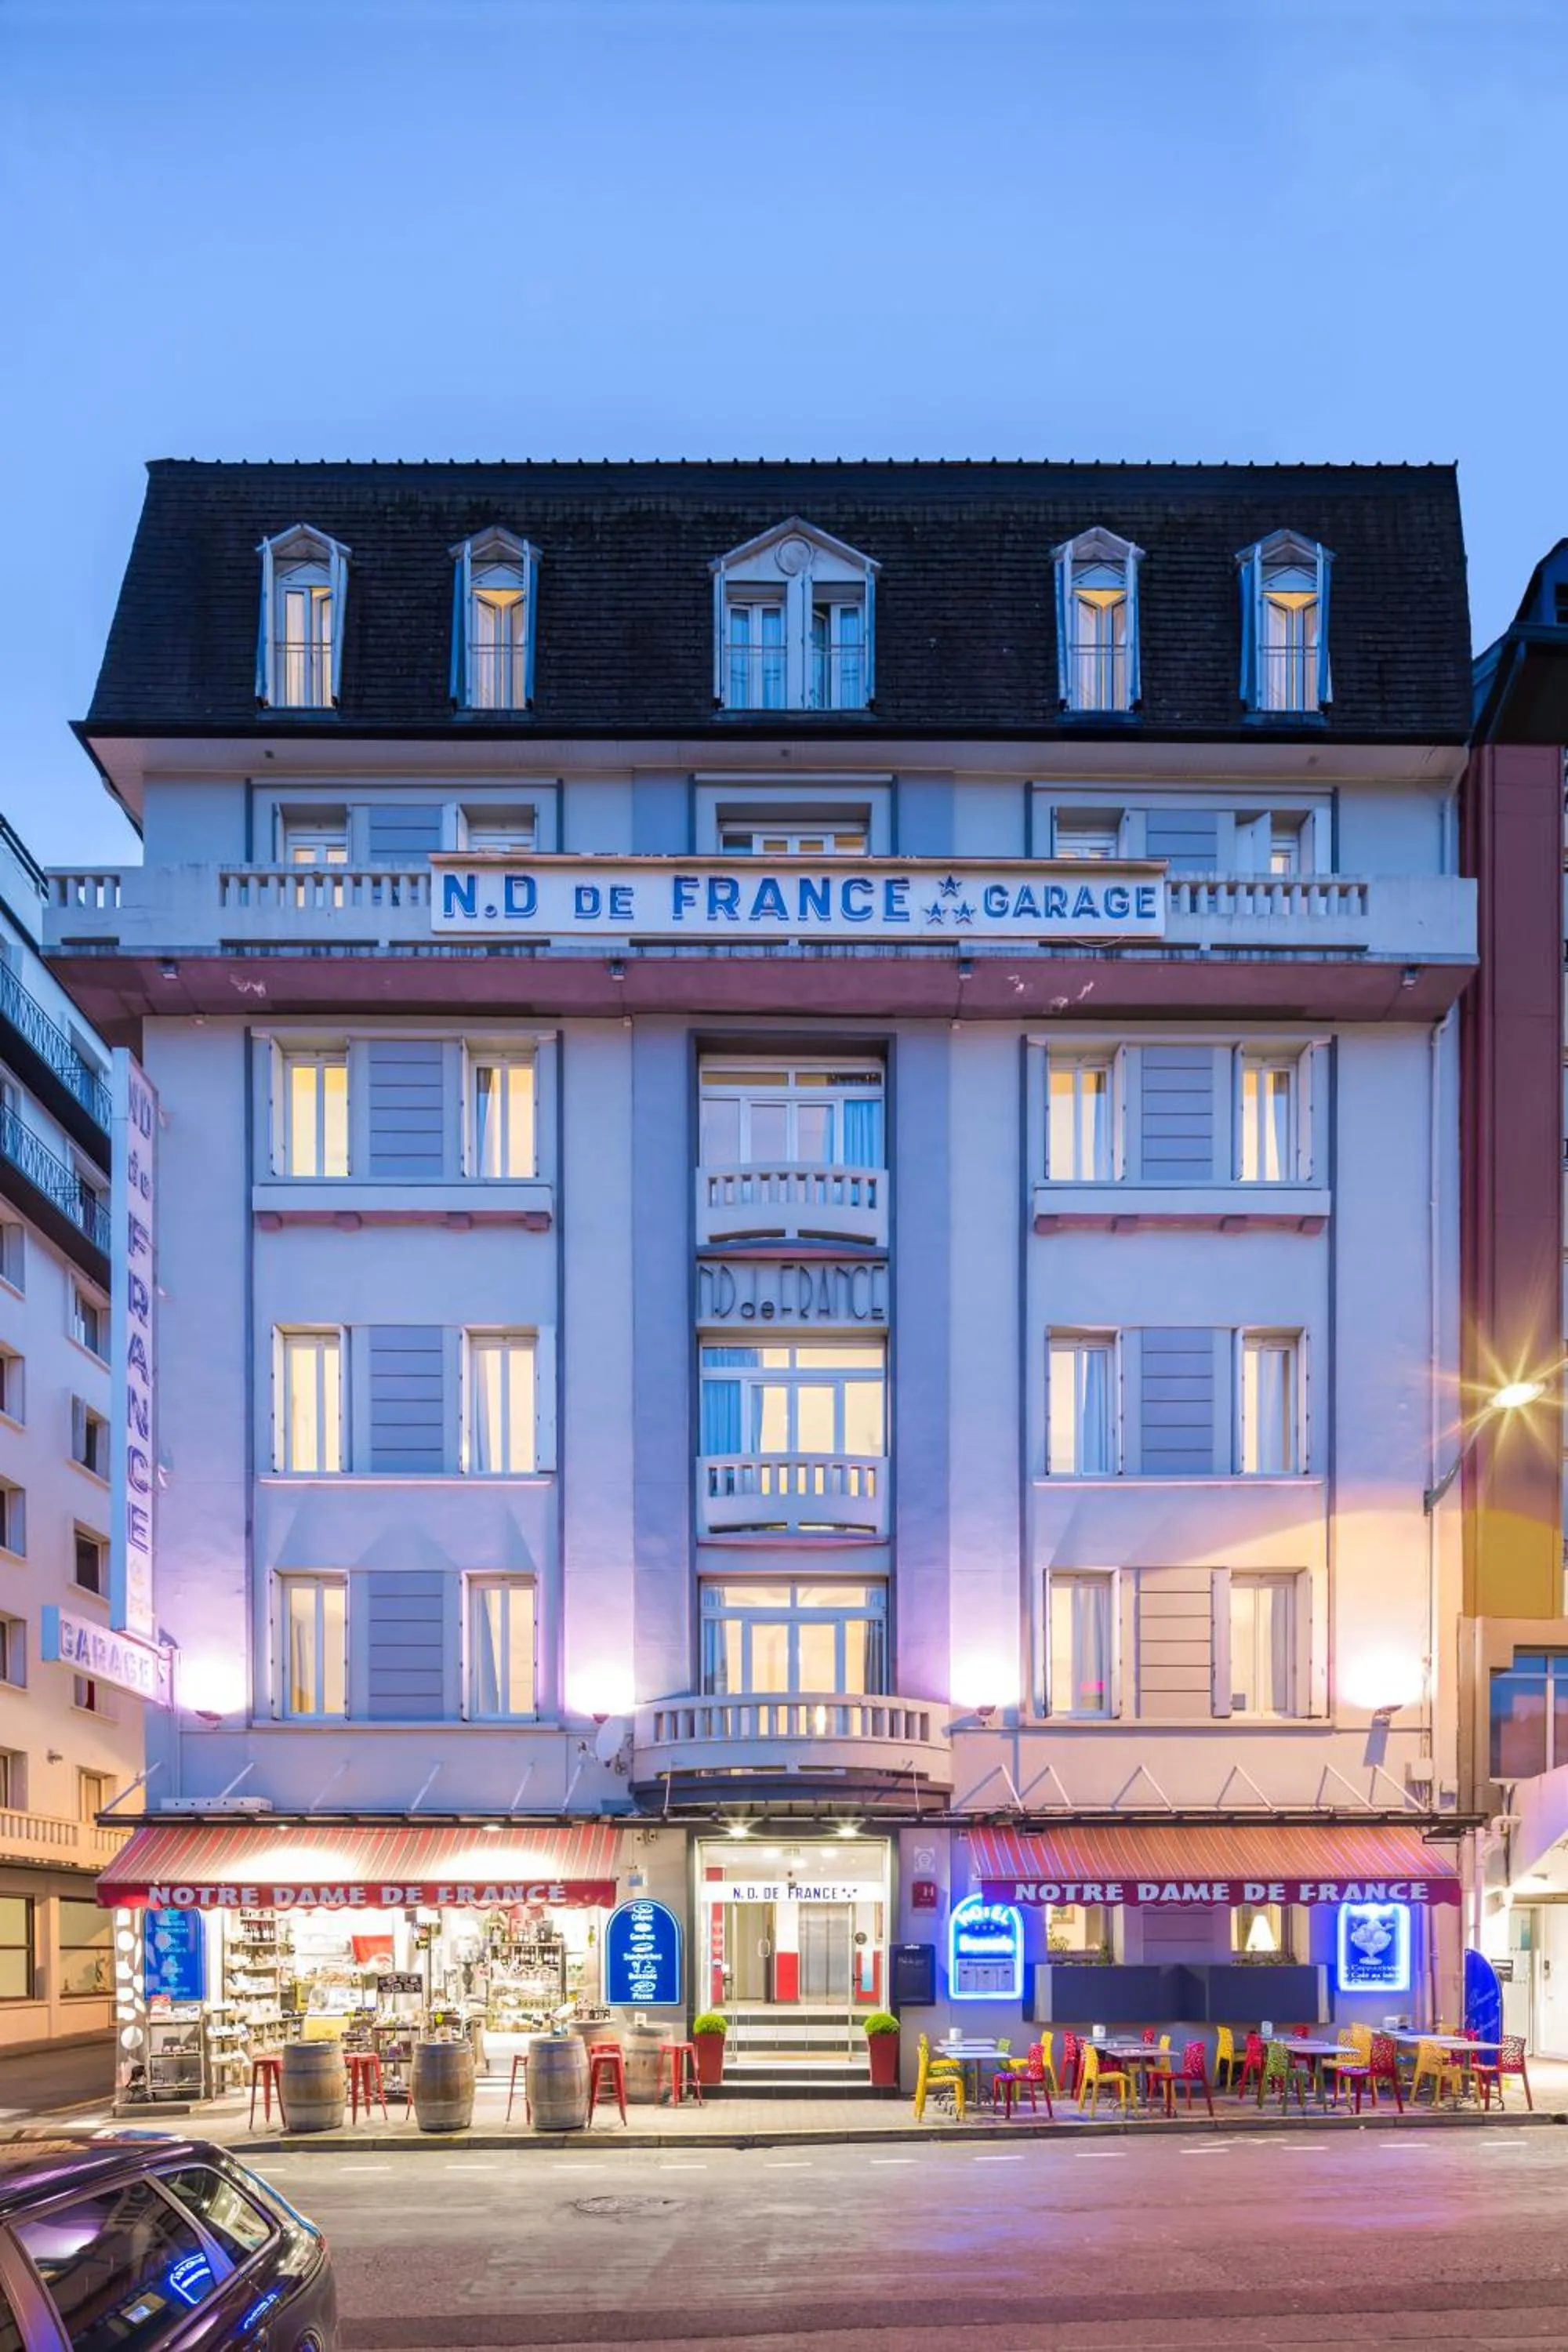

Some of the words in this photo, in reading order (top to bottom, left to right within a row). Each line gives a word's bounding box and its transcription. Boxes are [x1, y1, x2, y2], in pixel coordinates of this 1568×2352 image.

[443, 873, 538, 918] N.D
[574, 886, 634, 920] DE
[672, 874, 910, 922] FRANCE
[983, 884, 1156, 919] GARAGE
[780, 1265, 885, 1320] FRANCE
[127, 1211, 150, 1555] FRANCE
[60, 1619, 151, 1690] GARAGE
[148, 1886, 259, 1906] NOTRE
[272, 1886, 366, 1904] DAME
[381, 1886, 424, 1905] DE
[436, 1884, 566, 1904] FRANCE
[763, 1887, 779, 1900] DE
[787, 1887, 838, 1900] FRANCE
[1014, 1883, 1123, 1901] NOTRE
[1137, 1883, 1229, 1901] DAME
[1243, 1882, 1285, 1901] DE
[1299, 1882, 1429, 1901] FRANCE
